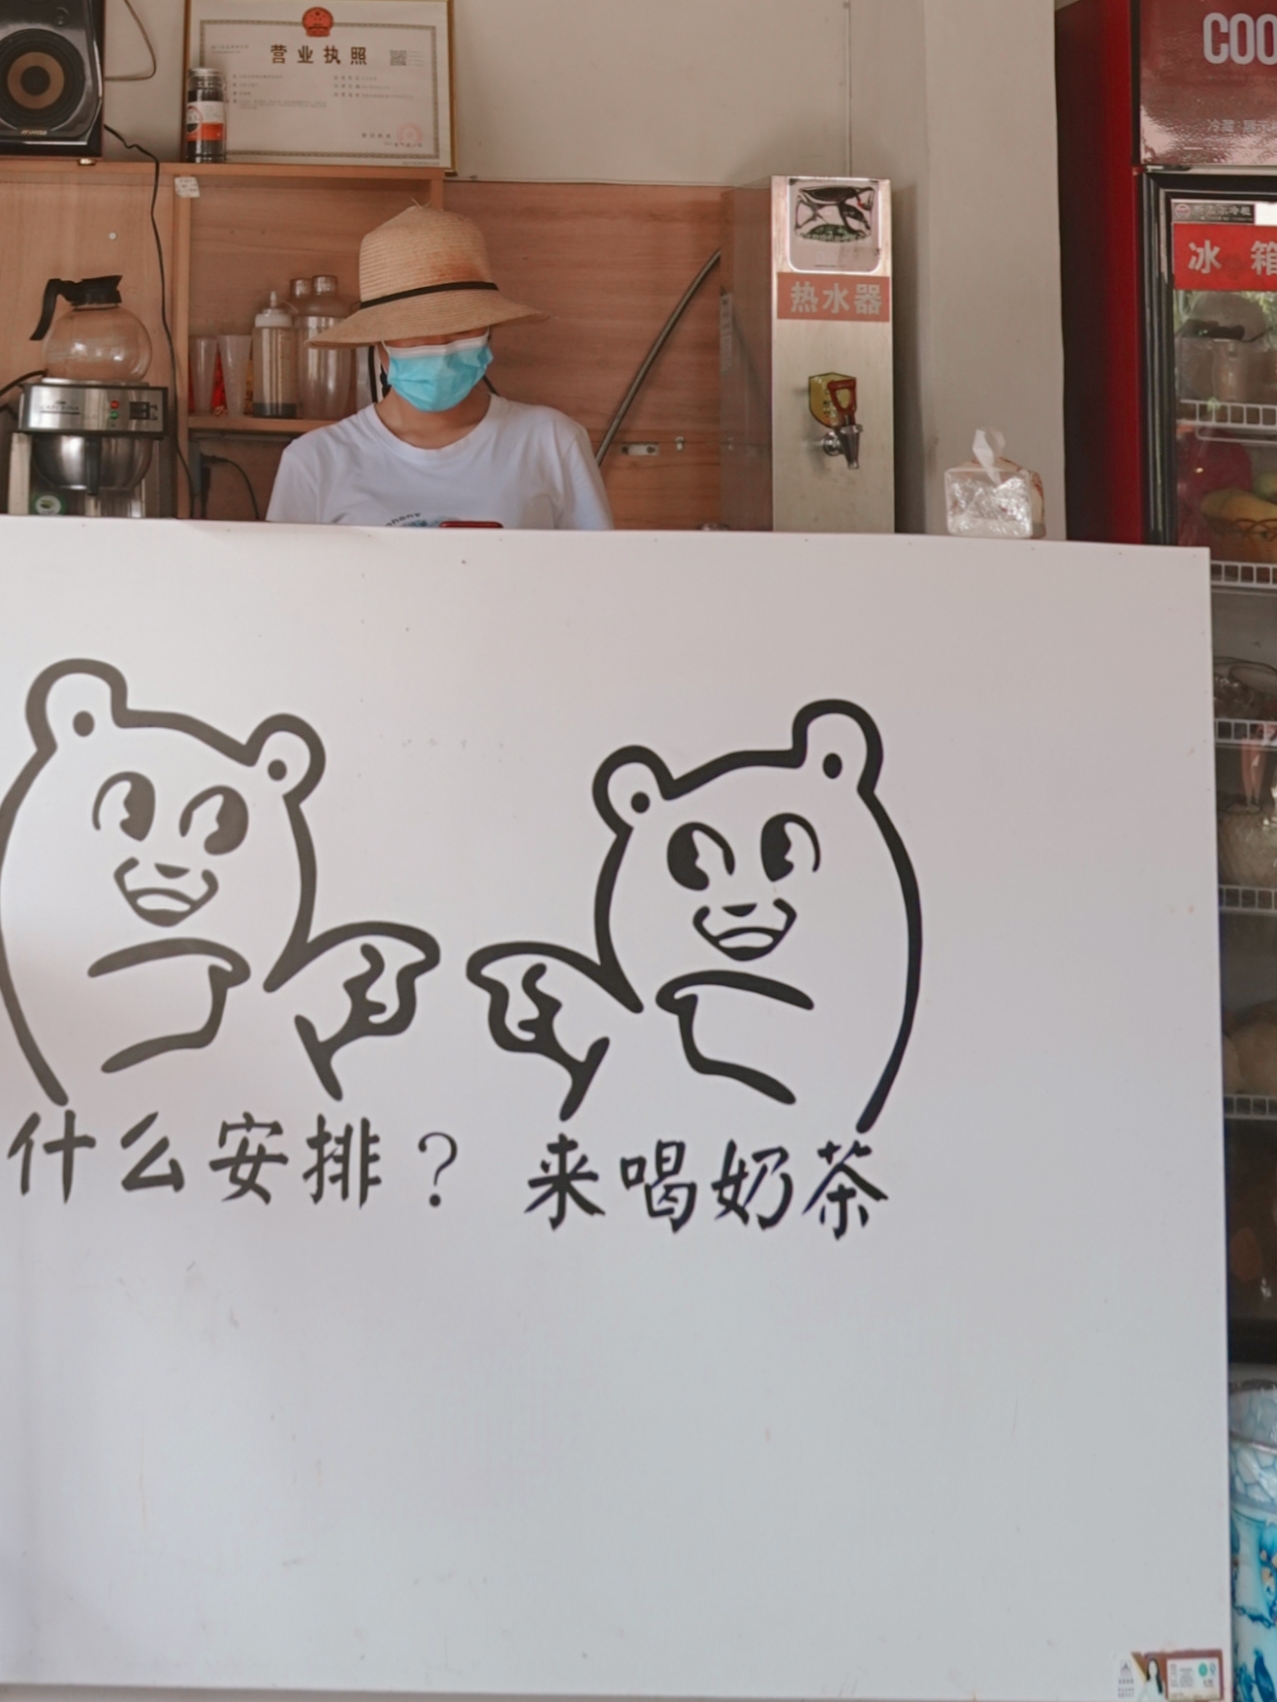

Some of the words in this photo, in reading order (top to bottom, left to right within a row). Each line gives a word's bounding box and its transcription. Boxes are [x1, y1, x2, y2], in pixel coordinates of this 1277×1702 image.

[269, 43, 368, 66] 营业执照
[1203, 11, 1277, 66] COO
[1187, 238, 1277, 277] 冰箱
[790, 281, 882, 316] 热水器
[523, 1132, 890, 1241] 来喝奶茶
